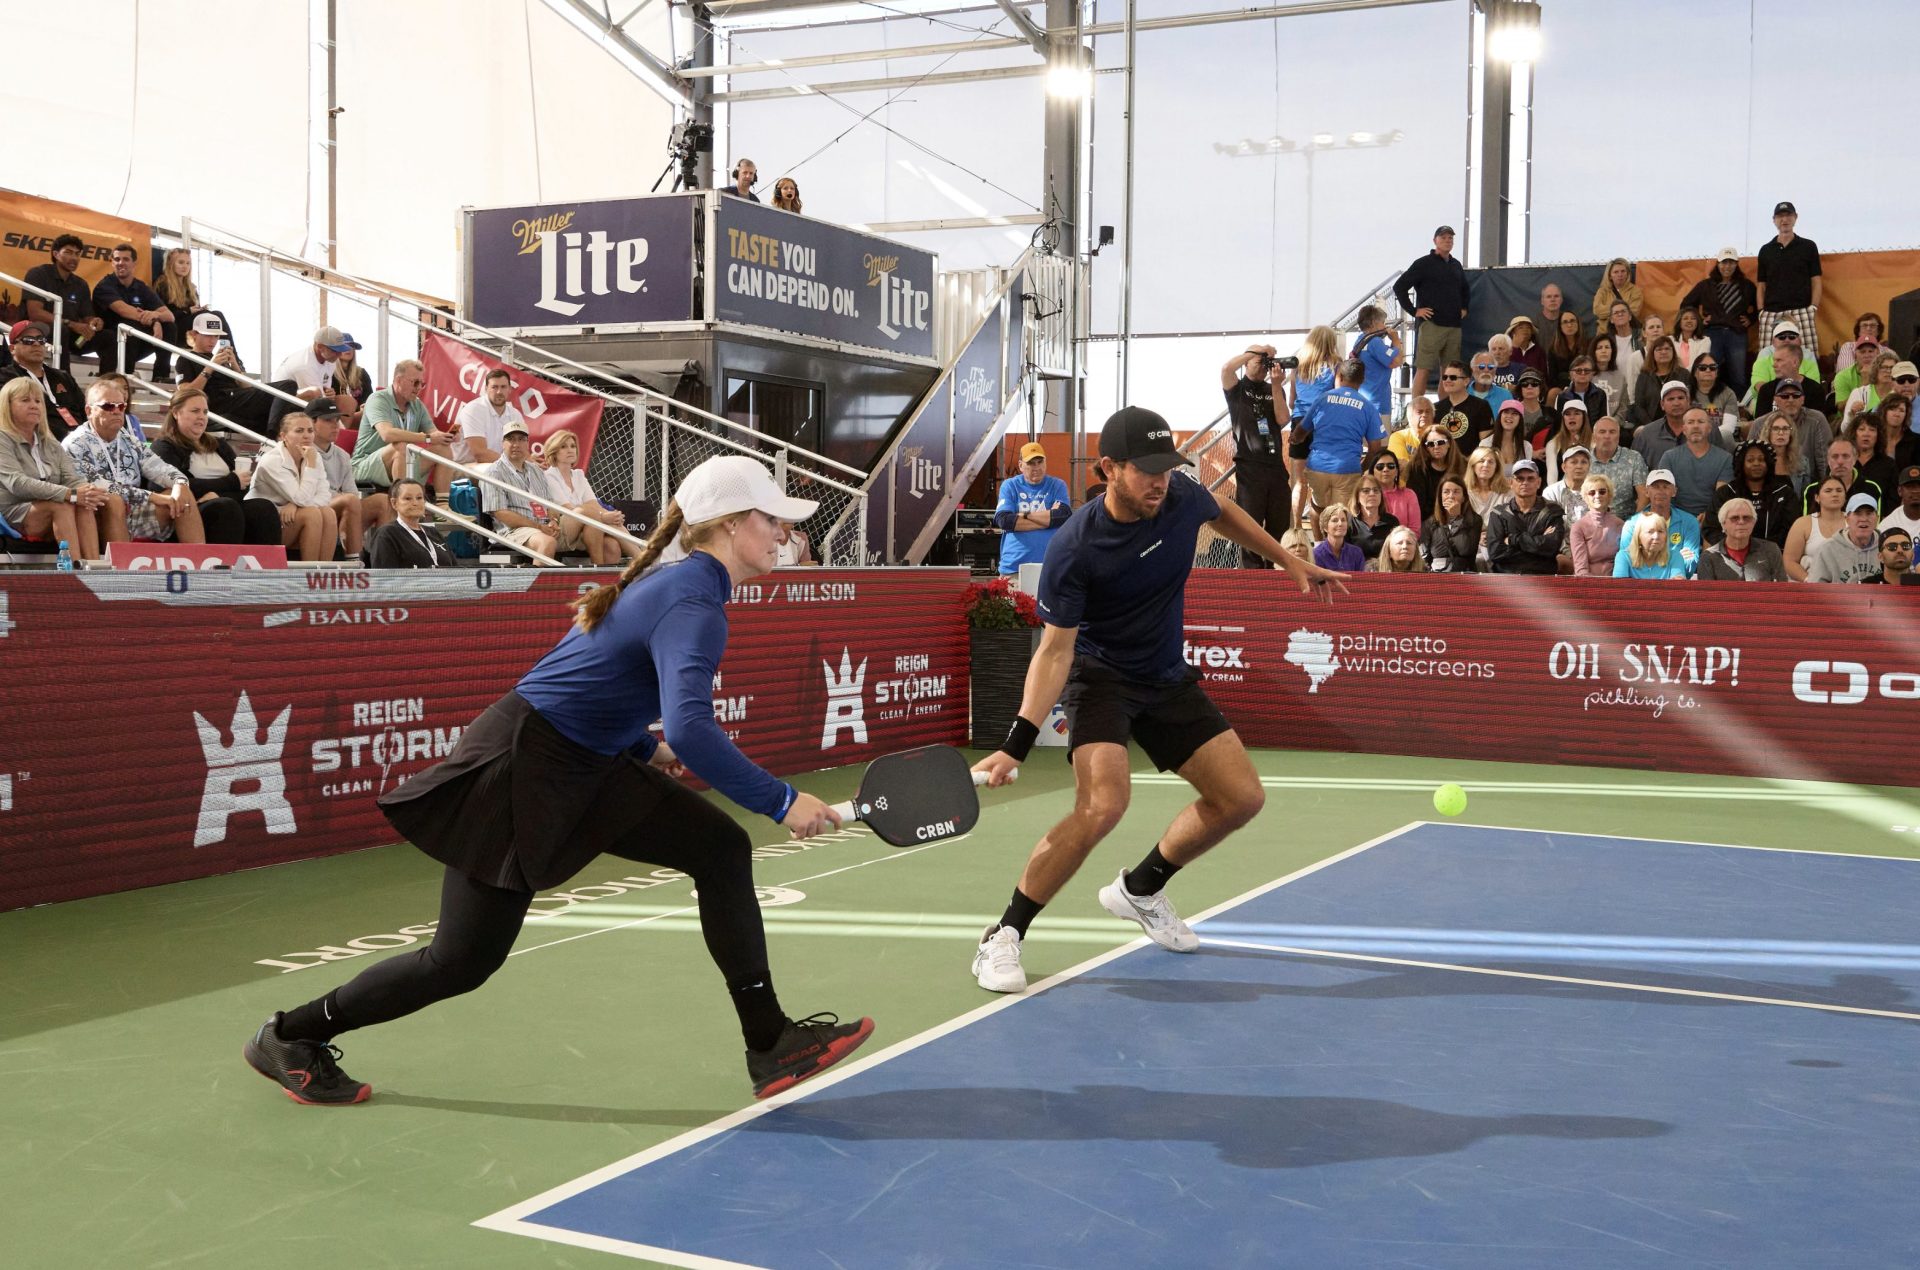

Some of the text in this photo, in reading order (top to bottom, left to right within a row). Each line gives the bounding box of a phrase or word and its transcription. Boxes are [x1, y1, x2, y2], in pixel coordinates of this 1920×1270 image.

[512, 211, 575, 255] Miller
[3, 232, 113, 263] SKEER
[728, 228, 816, 277] TASTE YOU
[534, 231, 649, 316] Lite
[864, 253, 899, 287] Miller
[728, 263, 860, 318] CAN DEPEND ON.
[877, 271, 930, 340] Lite
[976, 397, 994, 413] TIME
[1327, 395, 1364, 410] VOLUNTEER
[909, 456, 942, 499] Lite
[306, 572, 370, 590] WINS
[726, 585, 762, 604] VID
[786, 583, 856, 601] WILSON
[309, 607, 409, 625] BAIRD
[1339, 632, 1447, 654] palmetto
[895, 654, 928, 673] REIGN
[1344, 654, 1496, 678] windscreens
[1549, 641, 1741, 687] OH SNAP!
[875, 675, 946, 703] STORM
[1211, 673, 1244, 682] CREAM
[353, 698, 424, 727] REIGN
[879, 704, 942, 720] CLEAN ENERGY
[1583, 687, 1670, 718] pickling
[311, 725, 462, 773] STORM
[322, 779, 372, 797] CLEAN
[916, 820, 956, 840] CRBN
[777, 1045, 820, 1064] HEAD
